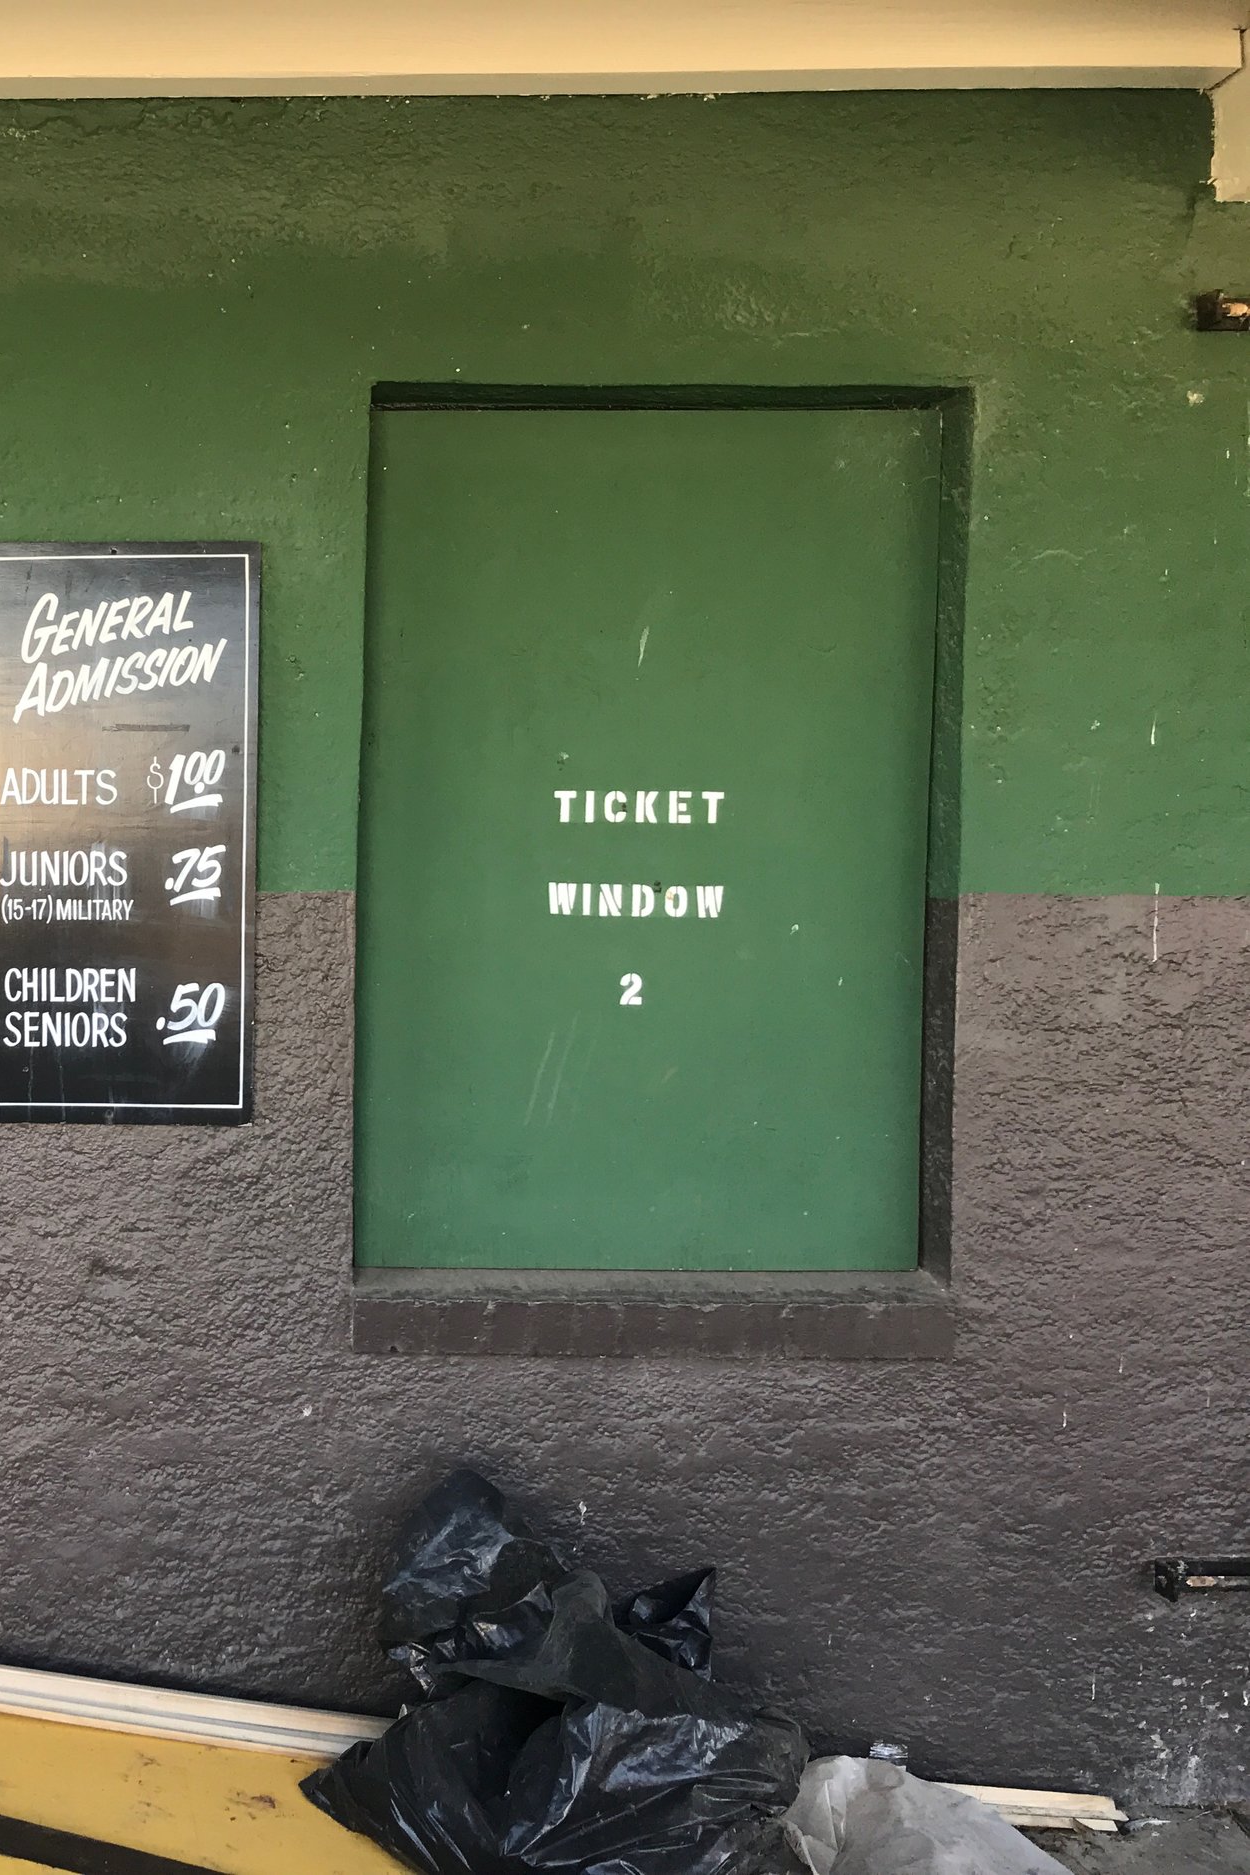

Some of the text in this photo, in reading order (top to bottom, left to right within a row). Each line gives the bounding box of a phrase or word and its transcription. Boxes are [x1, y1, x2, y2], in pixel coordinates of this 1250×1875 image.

[21, 590, 193, 664] GENERAL
[12, 638, 227, 724] ADMISSION
[0, 767, 118, 806] ADULTS
[554, 790, 725, 824] TICKET
[0, 844, 226, 892] JUNIORS .75
[1, 894, 134, 924] (15-17) MILITARY
[548, 882, 723, 918] WINDOW
[4, 967, 225, 1030] CHILDREN .50
[619, 973, 642, 1005] 2
[3, 1011, 127, 1048] SENIORS
